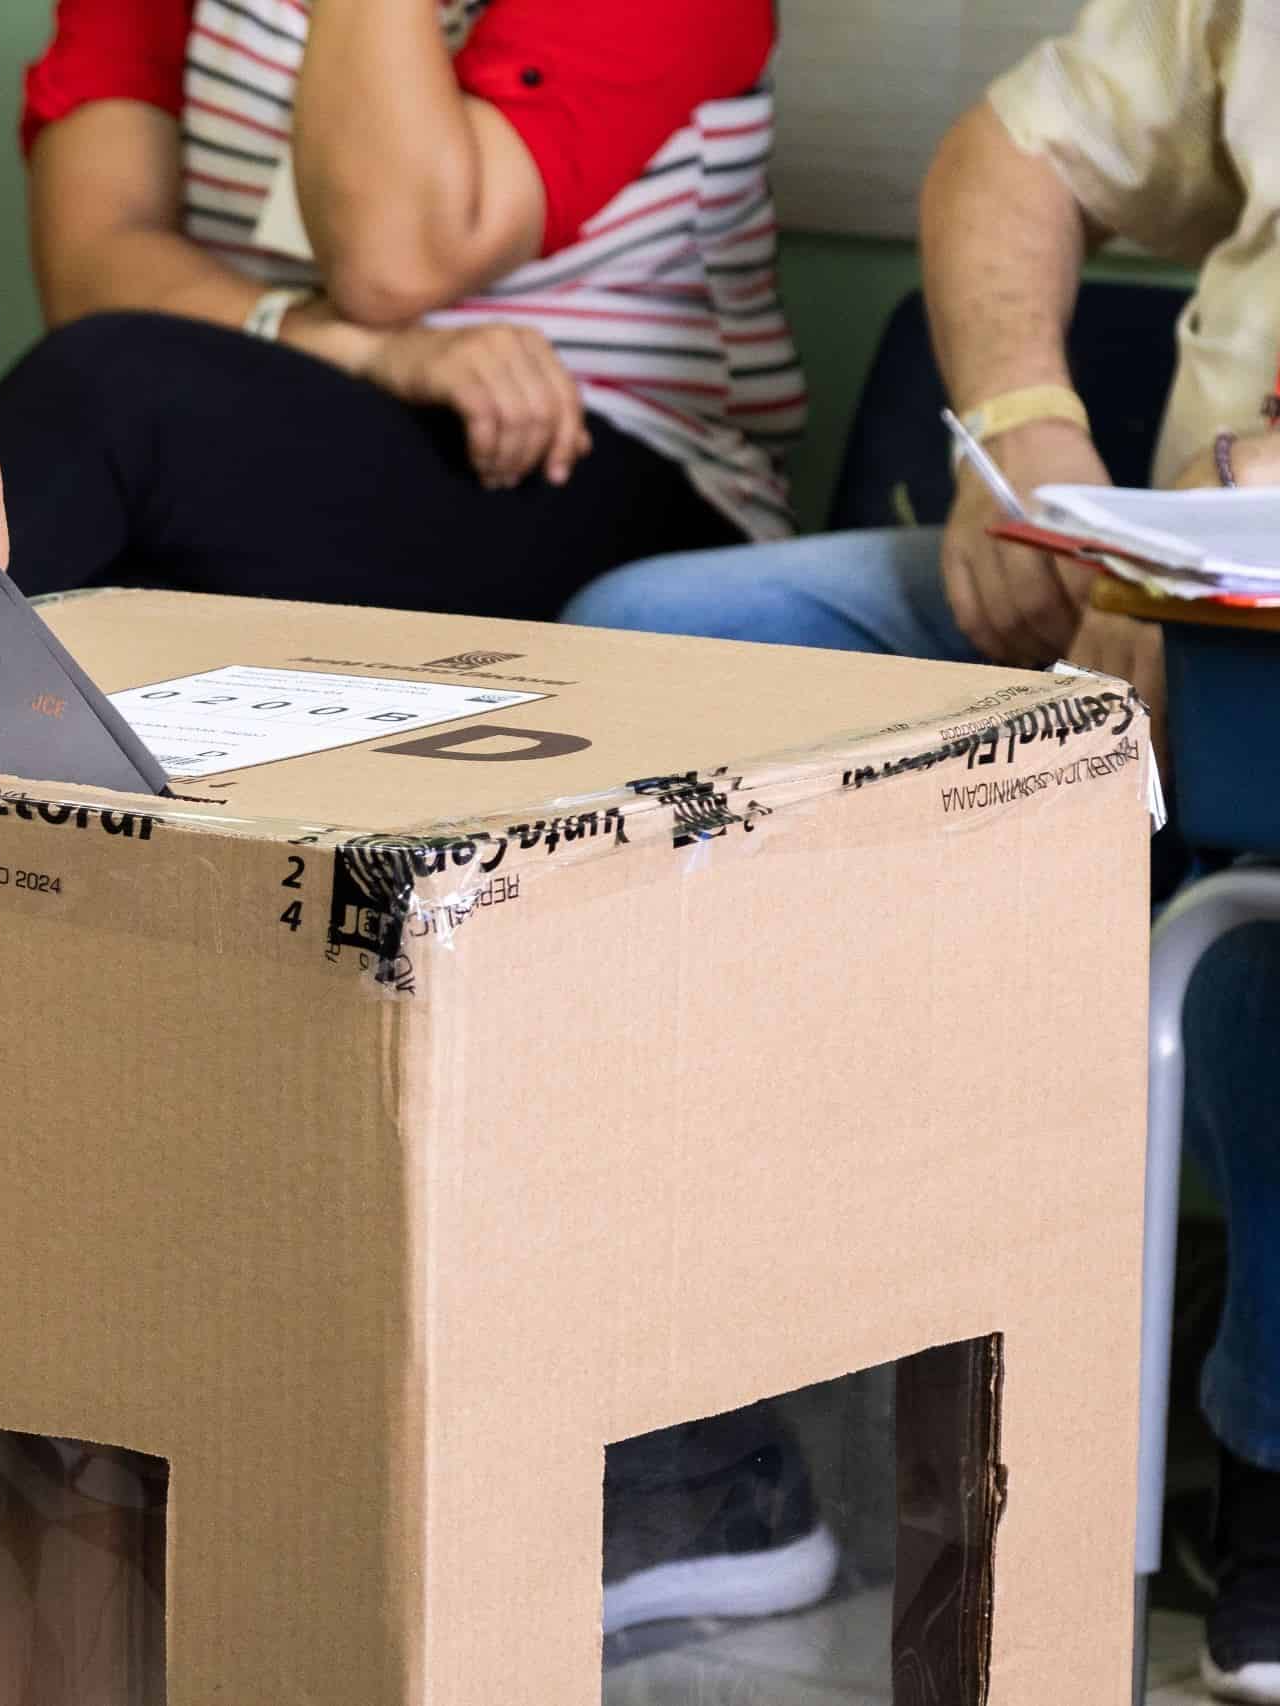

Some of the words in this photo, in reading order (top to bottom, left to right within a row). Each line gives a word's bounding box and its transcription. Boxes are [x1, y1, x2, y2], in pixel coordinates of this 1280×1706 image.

[31, 693, 66, 720] JCE
[369, 724, 593, 762] D
[1005, 691, 1134, 765] Central
[15, 869, 63, 895] 2024
[281, 855, 305, 889] 2
[279, 900, 304, 932] 4
